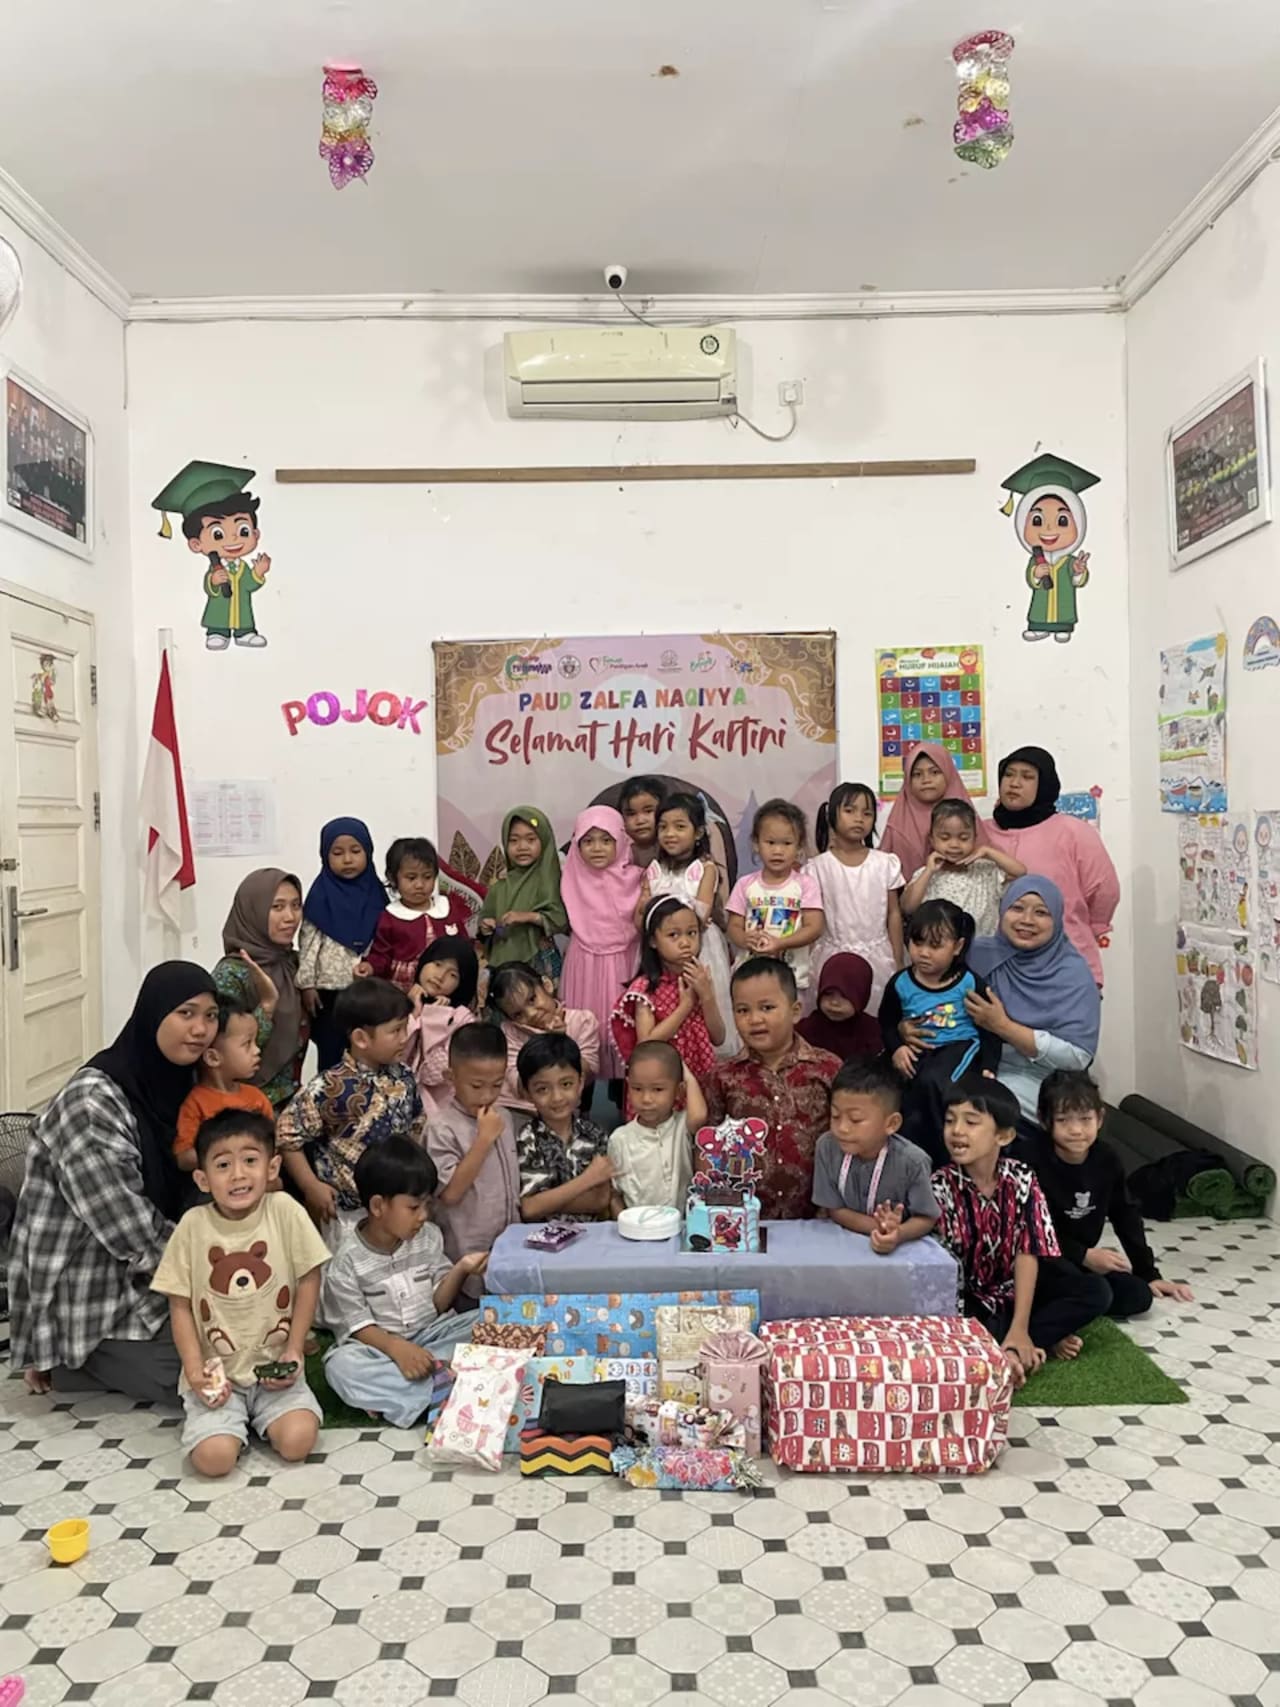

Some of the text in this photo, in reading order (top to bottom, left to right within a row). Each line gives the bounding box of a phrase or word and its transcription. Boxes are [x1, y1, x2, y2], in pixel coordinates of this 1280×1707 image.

[281, 689, 428, 736] POJOK
[519, 687, 748, 712] PAUD ZALFA NAQIYYA
[485, 712, 788, 768] Selamat Hari Kartini
